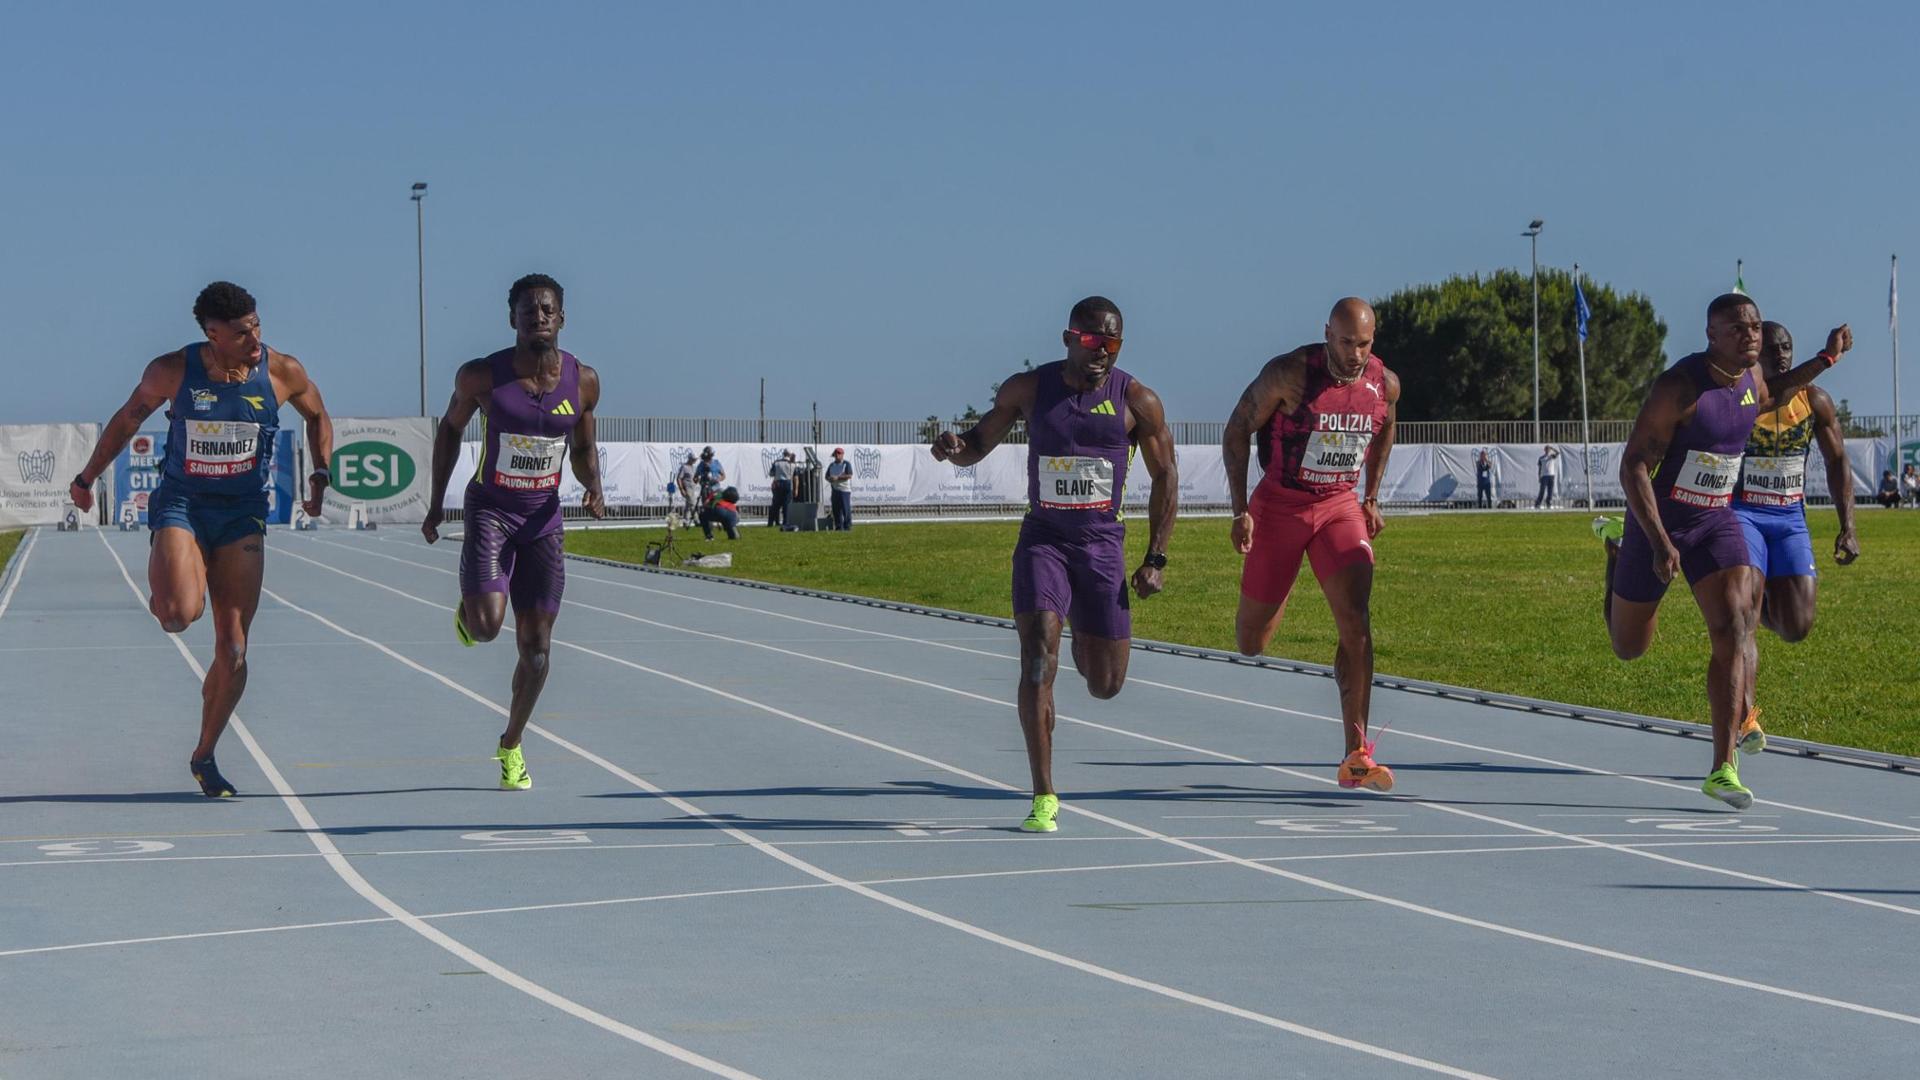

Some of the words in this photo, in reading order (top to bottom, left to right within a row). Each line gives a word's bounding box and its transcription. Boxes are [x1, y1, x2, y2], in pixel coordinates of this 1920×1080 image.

[1320, 413, 1372, 431] POLIZIA
[190, 439, 254, 455] FERNANDEZ
[510, 455, 553, 470] BURNET
[1317, 452, 1357, 467] JACOBS
[190, 462, 229, 475] SAVONA
[339, 454, 399, 487] ESI
[1055, 479, 1095, 496] GLAVE
[1694, 471, 1728, 489] LONGA
[1746, 474, 1802, 489] AMO-DADZIE
[1675, 489, 1711, 506] SAVONA
[66, 510, 77, 523] 6
[124, 508, 134, 523] 5
